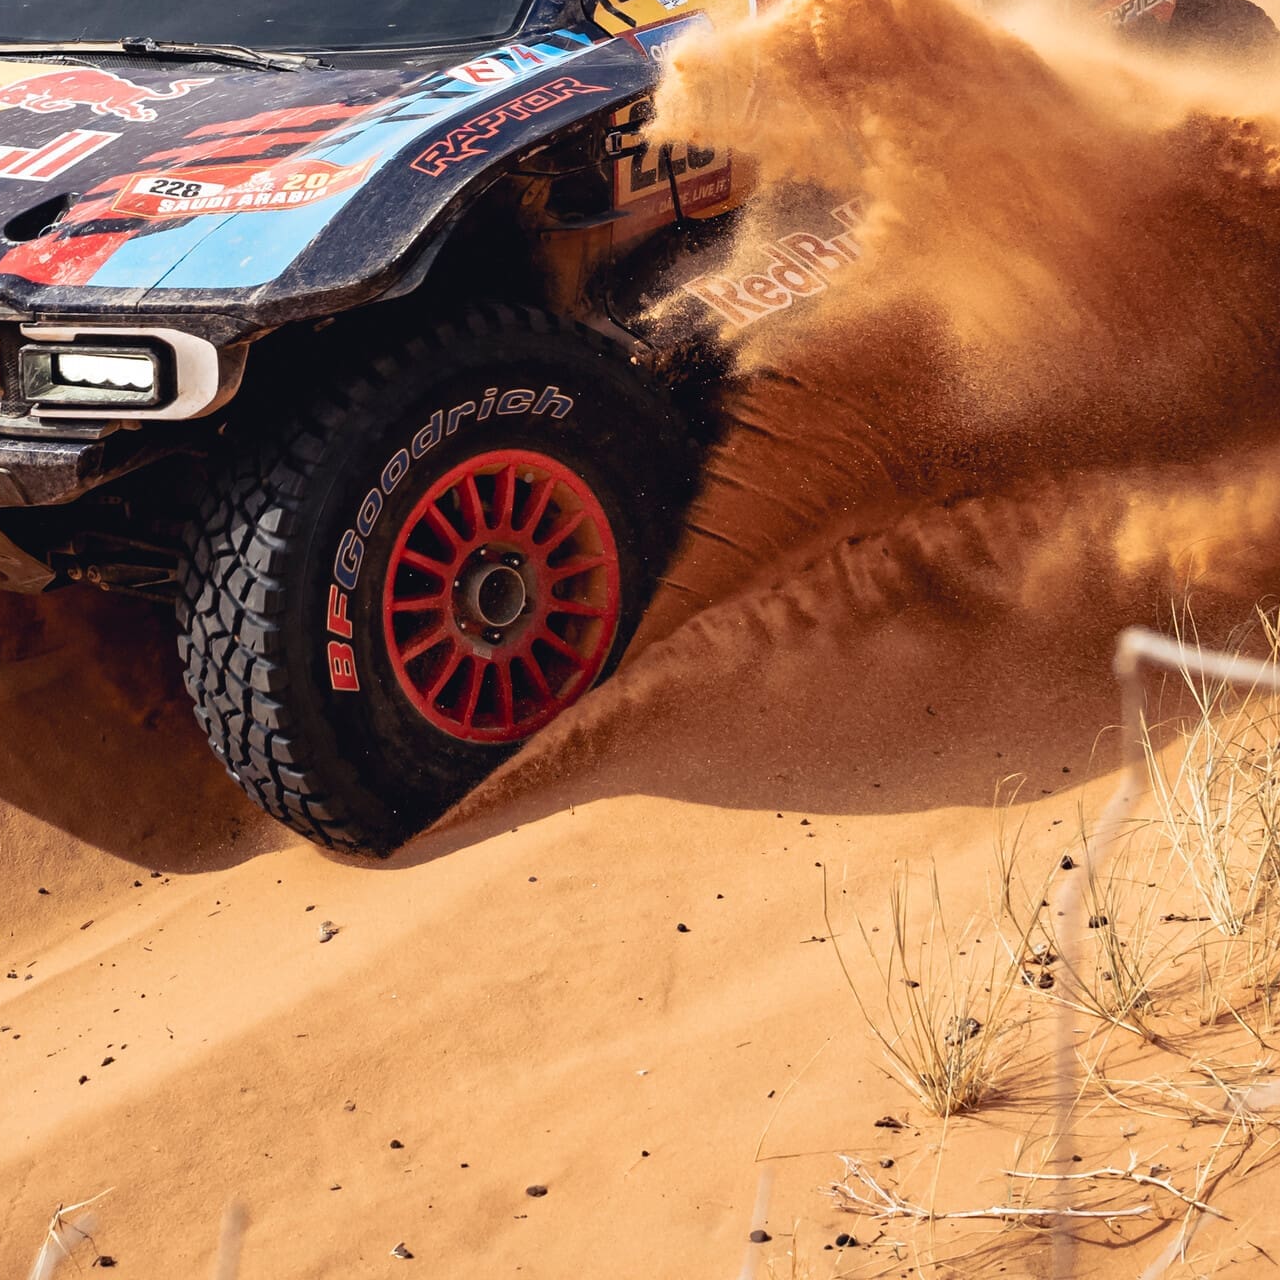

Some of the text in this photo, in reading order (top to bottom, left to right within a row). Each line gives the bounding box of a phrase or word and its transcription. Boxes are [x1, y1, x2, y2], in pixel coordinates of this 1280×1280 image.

[410, 76, 613, 177] RAPTOR
[148, 179, 202, 198] 228
[157, 196, 232, 213] SAUDI
[237, 187, 329, 207] ARABIA
[693, 183, 714, 202] LIVE
[682, 242, 828, 329] Red
[326, 385, 574, 692] BFGoodrich
